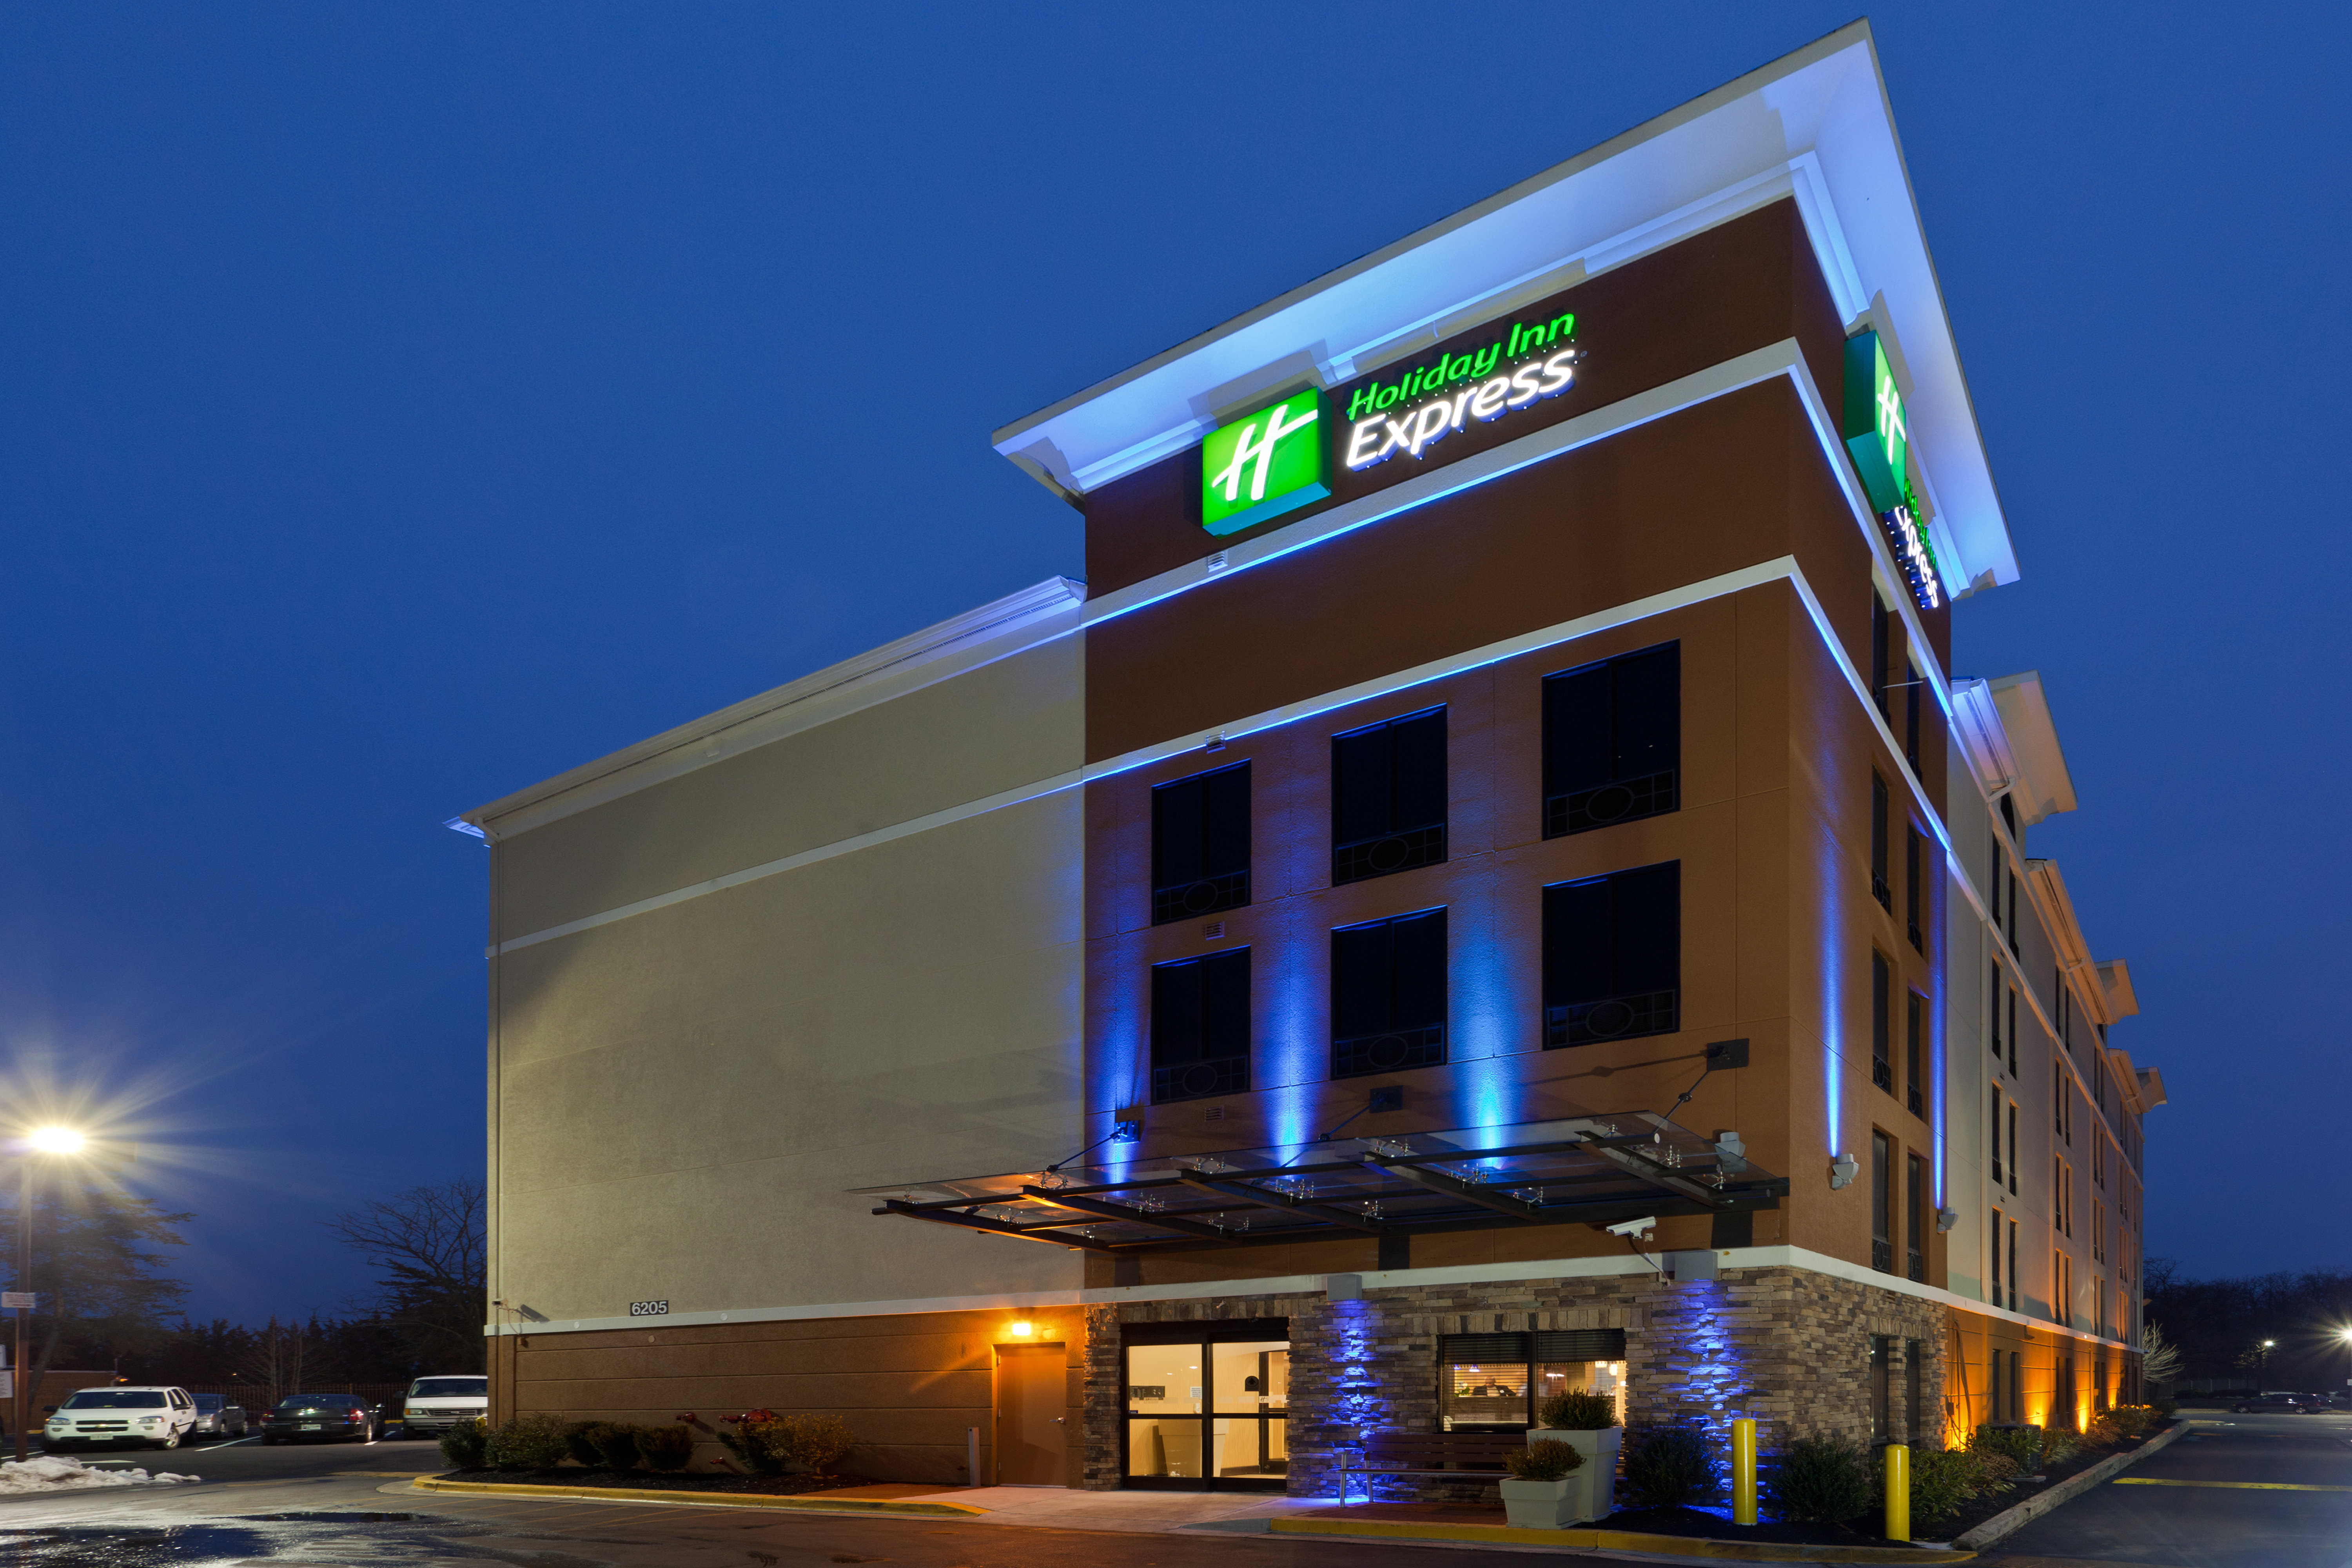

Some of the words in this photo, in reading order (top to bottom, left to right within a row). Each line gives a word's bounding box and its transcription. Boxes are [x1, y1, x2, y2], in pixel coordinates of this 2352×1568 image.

[1346, 350, 1575, 467] Express
[1347, 342, 1501, 420] Holiday
[1507, 314, 1574, 357] Inn
[632, 1301, 667, 1315] 6205
